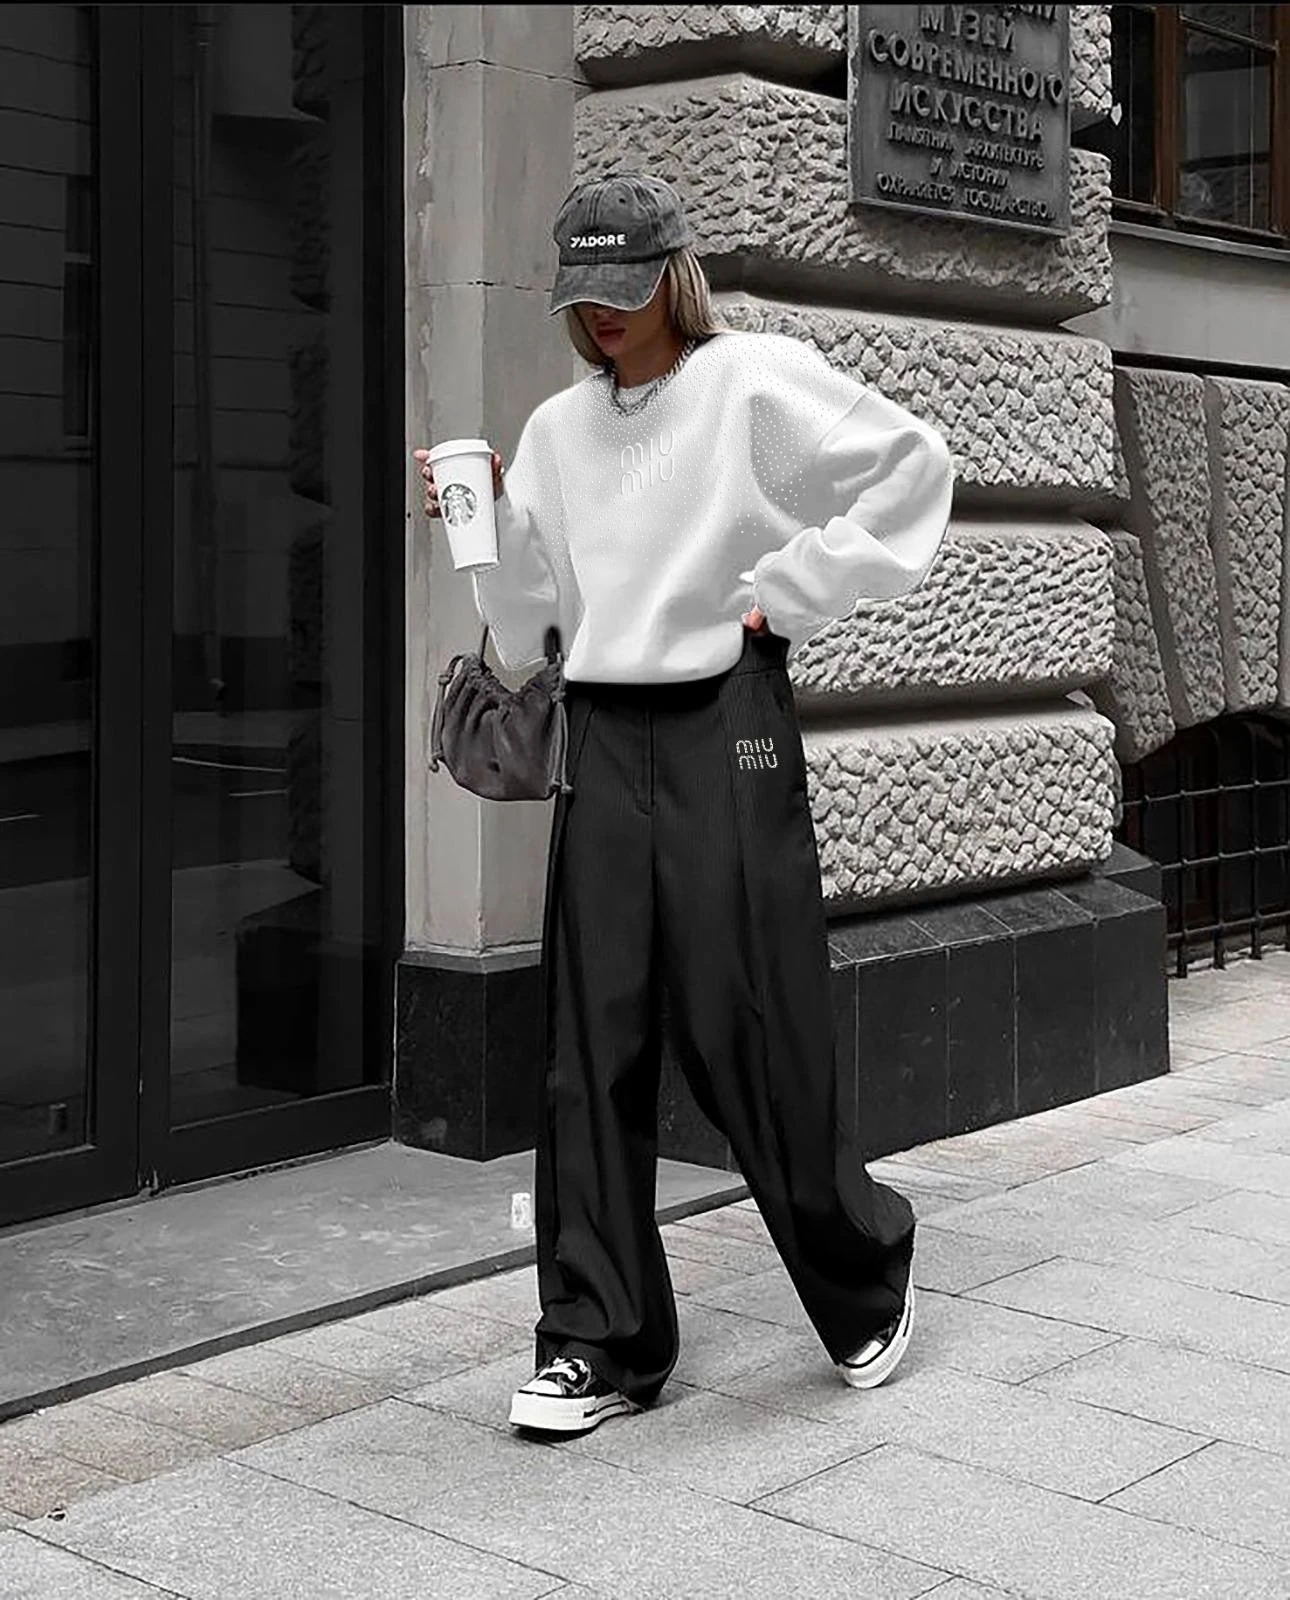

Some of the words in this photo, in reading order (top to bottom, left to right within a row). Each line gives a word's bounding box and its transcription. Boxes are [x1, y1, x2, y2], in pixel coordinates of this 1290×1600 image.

[920, 5, 1013, 49] МУЗЕЙ
[869, 29, 1063, 101] СОВРЕМЕННОГО
[890, 82, 1042, 140] ИСКУССТВА
